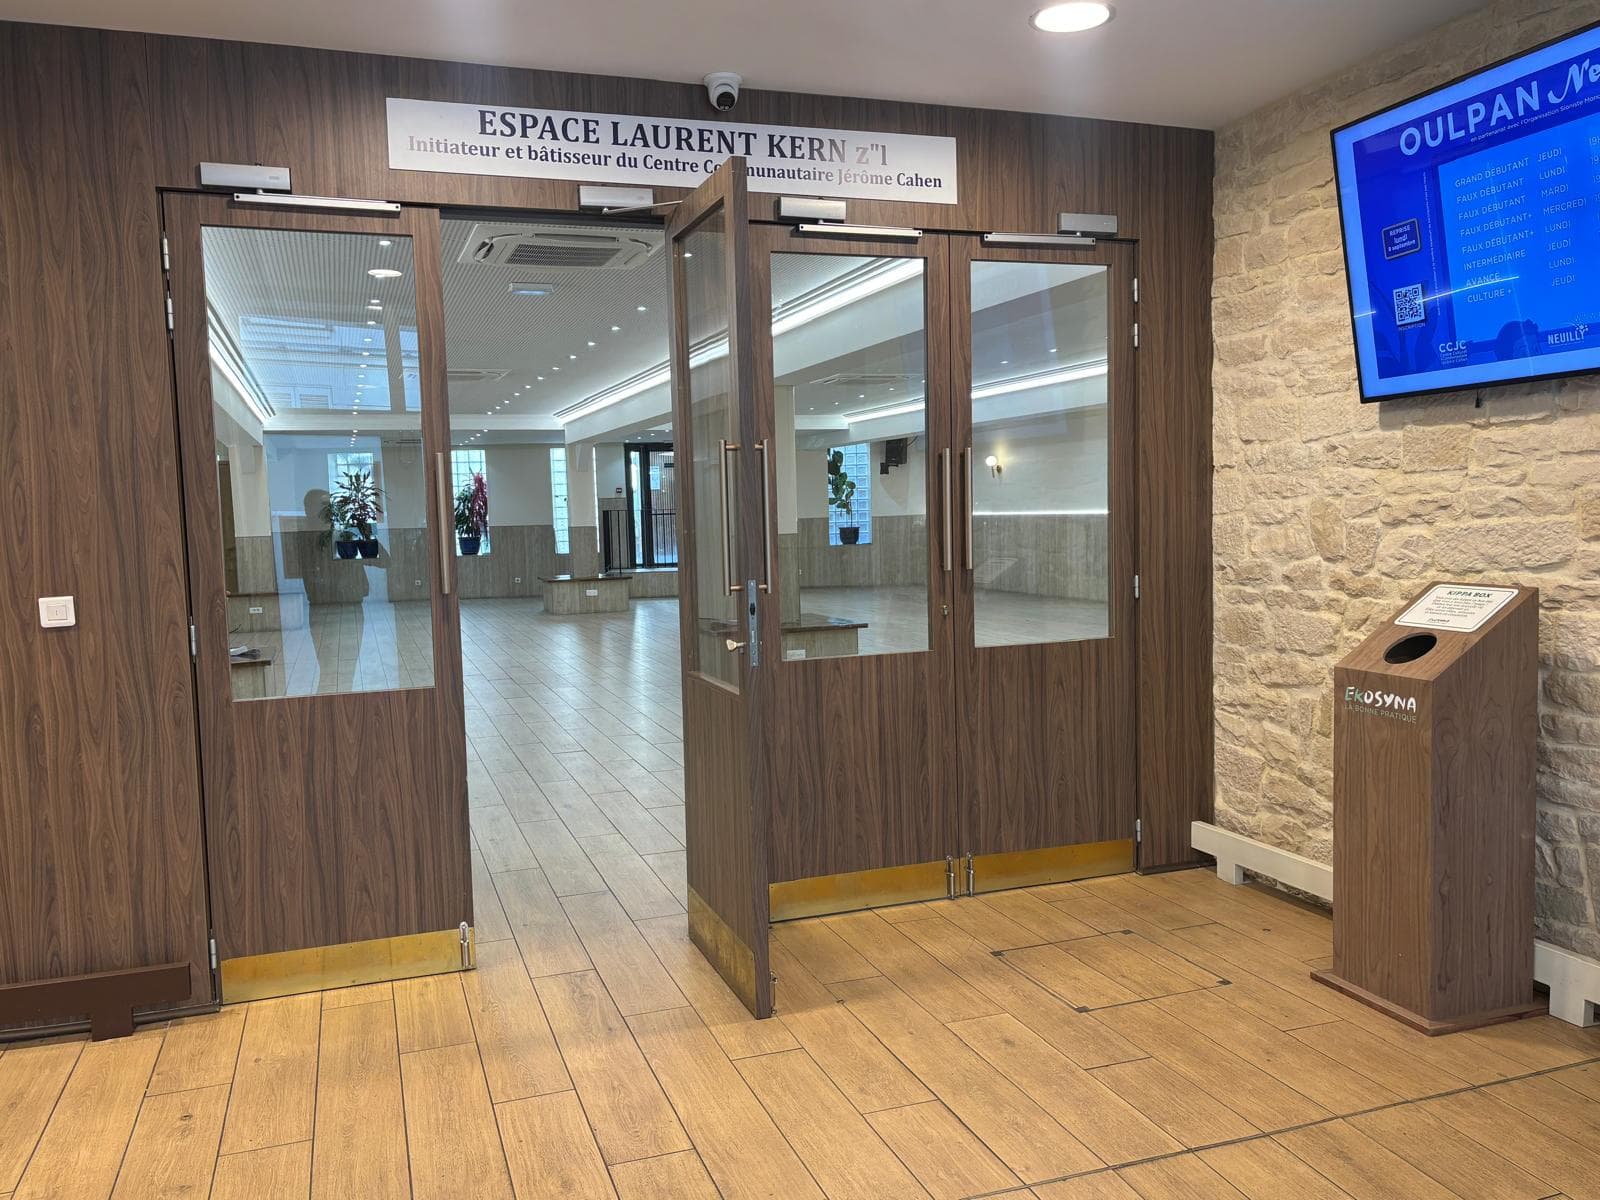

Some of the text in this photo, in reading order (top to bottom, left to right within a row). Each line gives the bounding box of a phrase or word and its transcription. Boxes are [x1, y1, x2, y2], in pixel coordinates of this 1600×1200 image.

[1400, 81, 1540, 155] OULPAN
[478, 109, 888, 166] ESPACE LAURENT KERN z"l
[408, 135, 943, 188] Initiateur et bâtisseur du Centre Comunautaire Jérôme Cahen
[1538, 147, 1562, 162] JEUDI
[1454, 172, 1483, 188] GRAND
[1539, 165, 1566, 180] LUNDI
[1456, 190, 1479, 204] FAUX
[1541, 183, 1569, 198] MARDI
[1458, 207, 1480, 221] FAUX
[1543, 198, 1587, 215] MERCREDI
[1460, 223, 1482, 237] FAUX
[1545, 219, 1571, 233] LUNDI
[1462, 241, 1484, 254] FAUX
[1546, 238, 1571, 252] JEUDI
[1548, 256, 1575, 269] LUNDI
[1551, 274, 1576, 287] JEUDI
[1467, 288, 1505, 303] CULTURE
[1547, 329, 1584, 345] NEUILLY
[1439, 340, 1467, 353] CCJC
[1344, 686, 1417, 713] EKOSYNA
